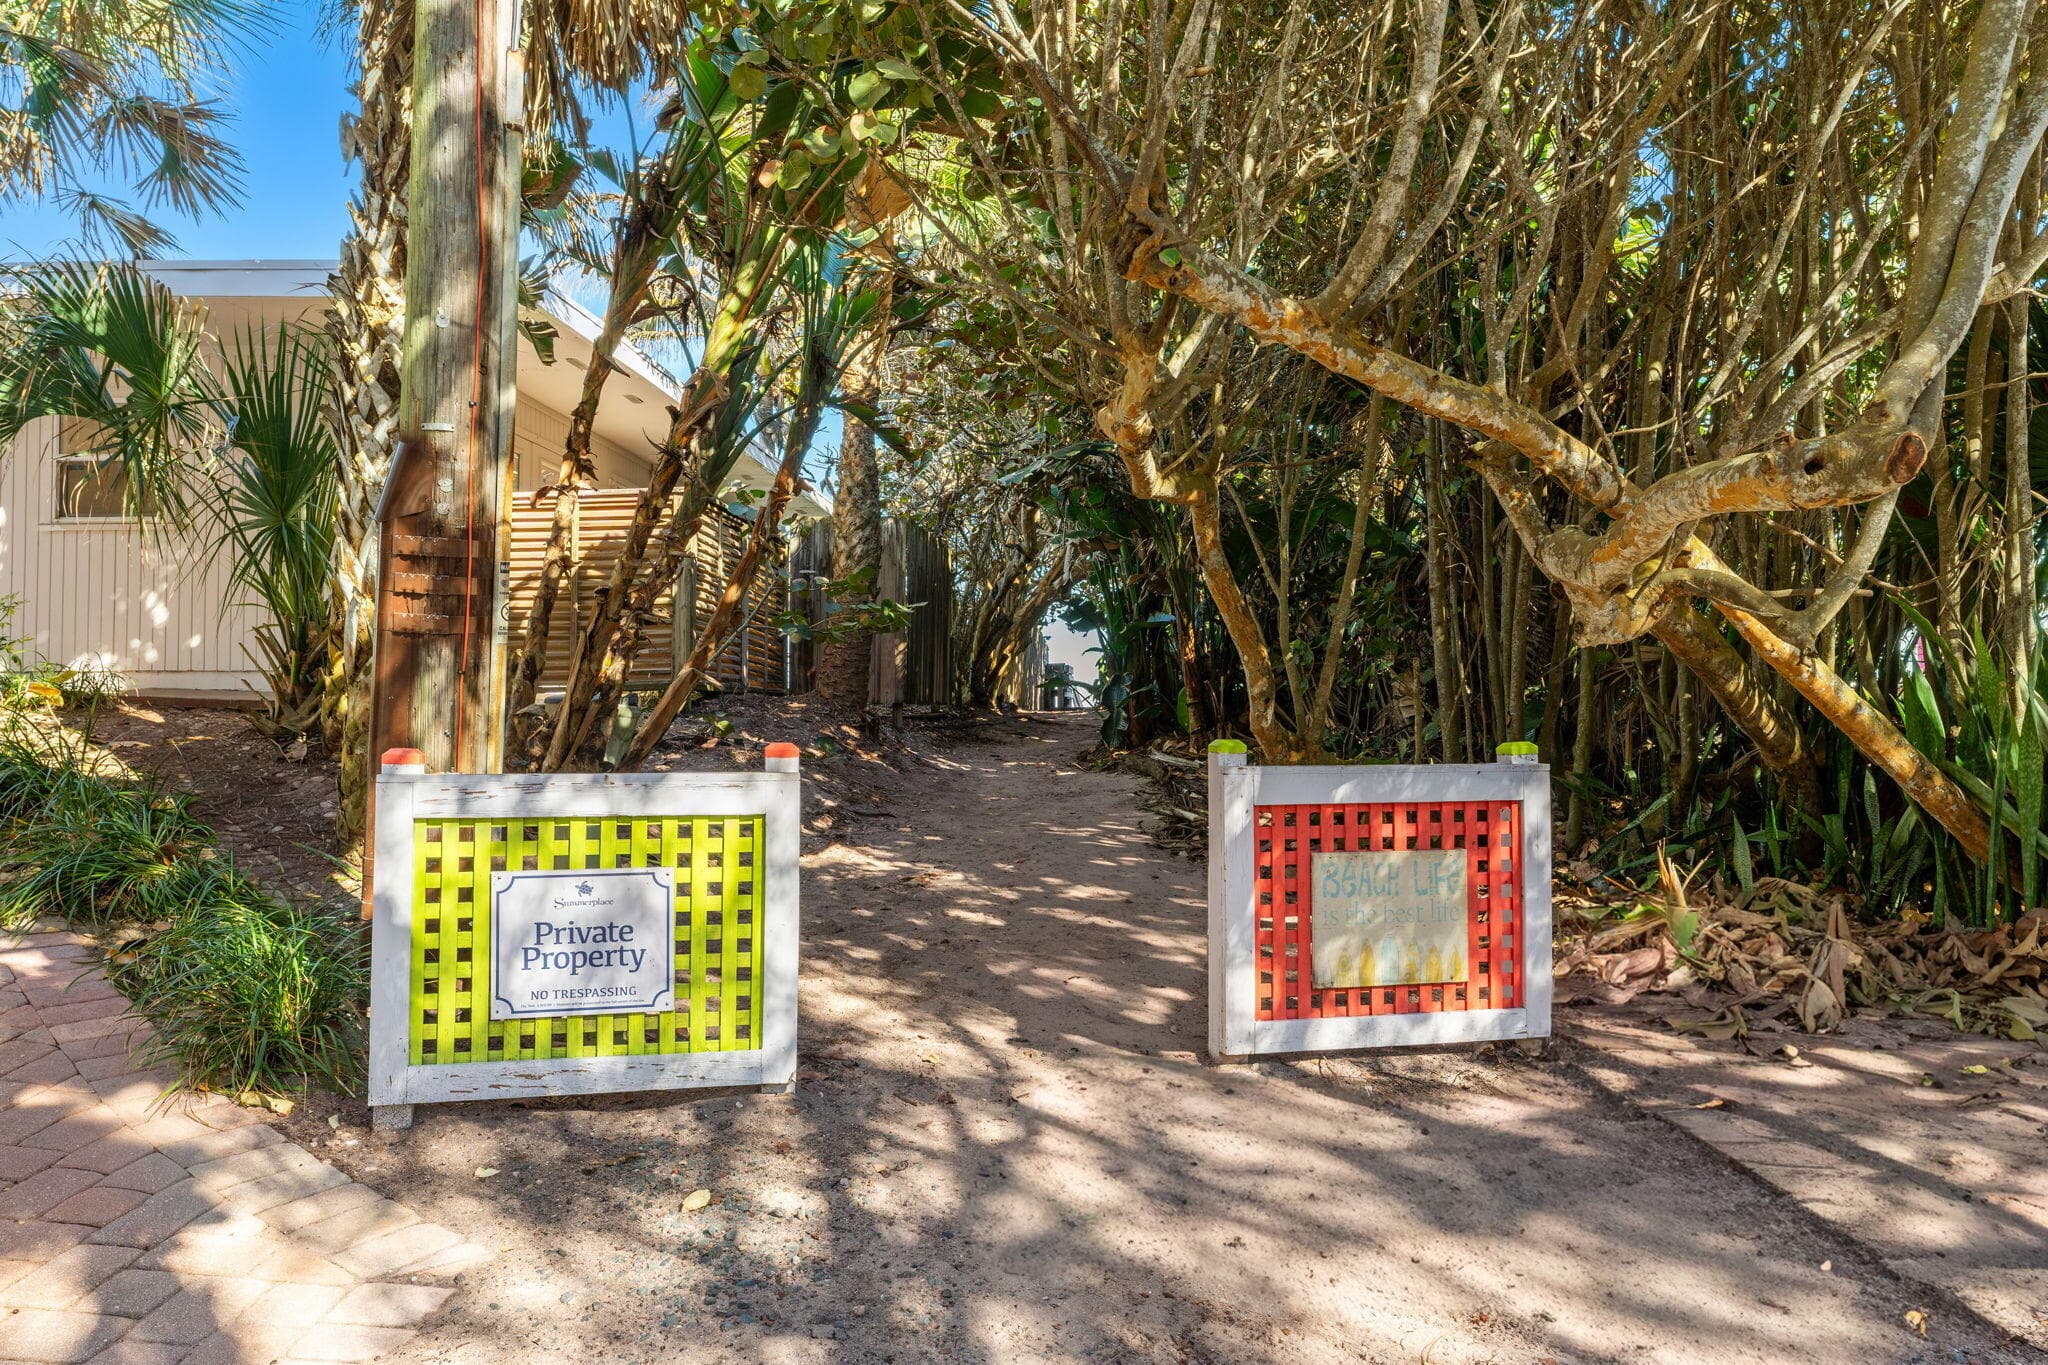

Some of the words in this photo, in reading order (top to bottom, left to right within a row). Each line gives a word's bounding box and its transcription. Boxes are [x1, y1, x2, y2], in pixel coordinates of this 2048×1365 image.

[554, 896, 615, 910] Summerplace
[1323, 904, 1339, 926] is
[1345, 901, 1377, 926] the
[1383, 903, 1425, 924] best
[1430, 898, 1460, 922] life
[533, 920, 634, 946] Private
[521, 945, 647, 976] Property
[530, 990, 549, 1001] NO
[552, 986, 637, 1000] TRESPASSING
